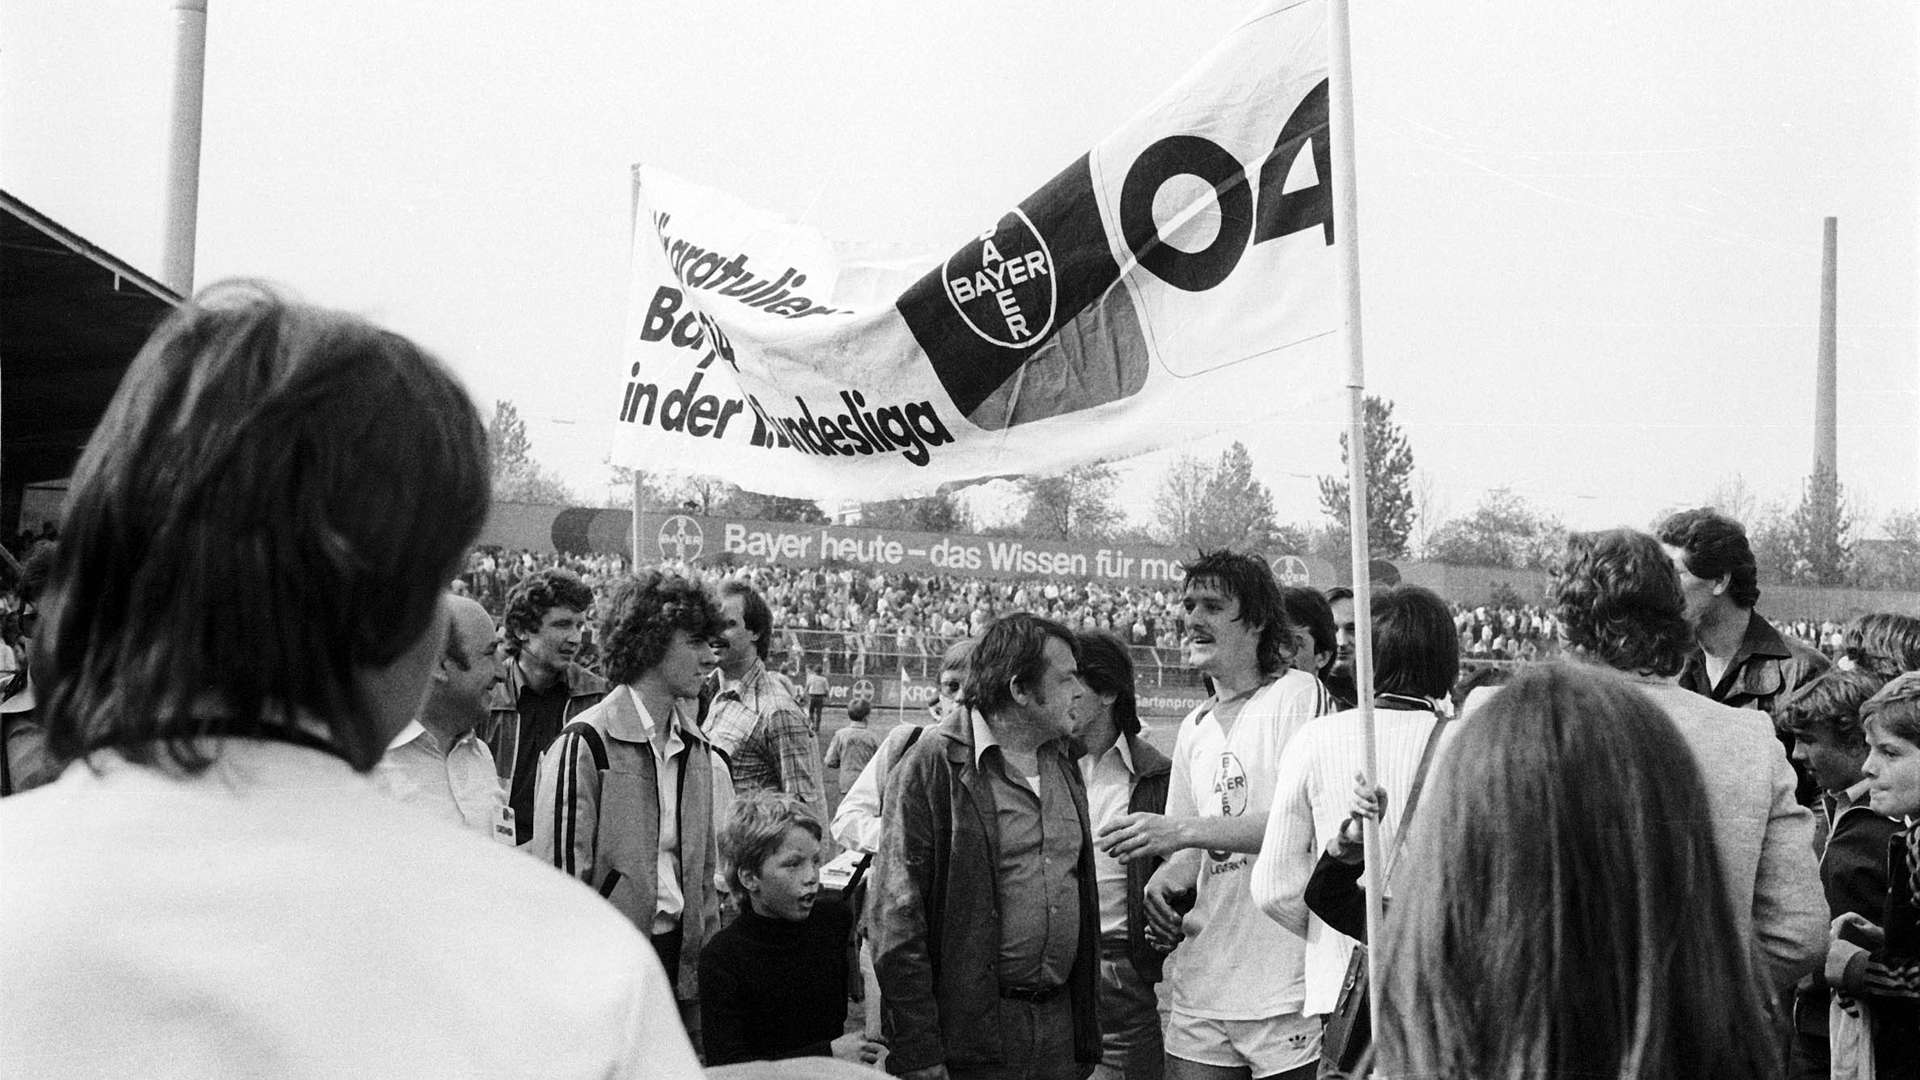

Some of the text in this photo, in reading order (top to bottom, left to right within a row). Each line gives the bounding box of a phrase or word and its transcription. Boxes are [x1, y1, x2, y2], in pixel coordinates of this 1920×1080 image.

[950, 250, 1048, 304] BAYER
[620, 361, 659, 426] in
[660, 371, 744, 440] der
[724, 523, 812, 564] Bayer
[820, 530, 904, 565] heute
[929, 537, 982, 570] das
[986, 541, 1087, 576] Wissen
[1096, 548, 1134, 579] für
